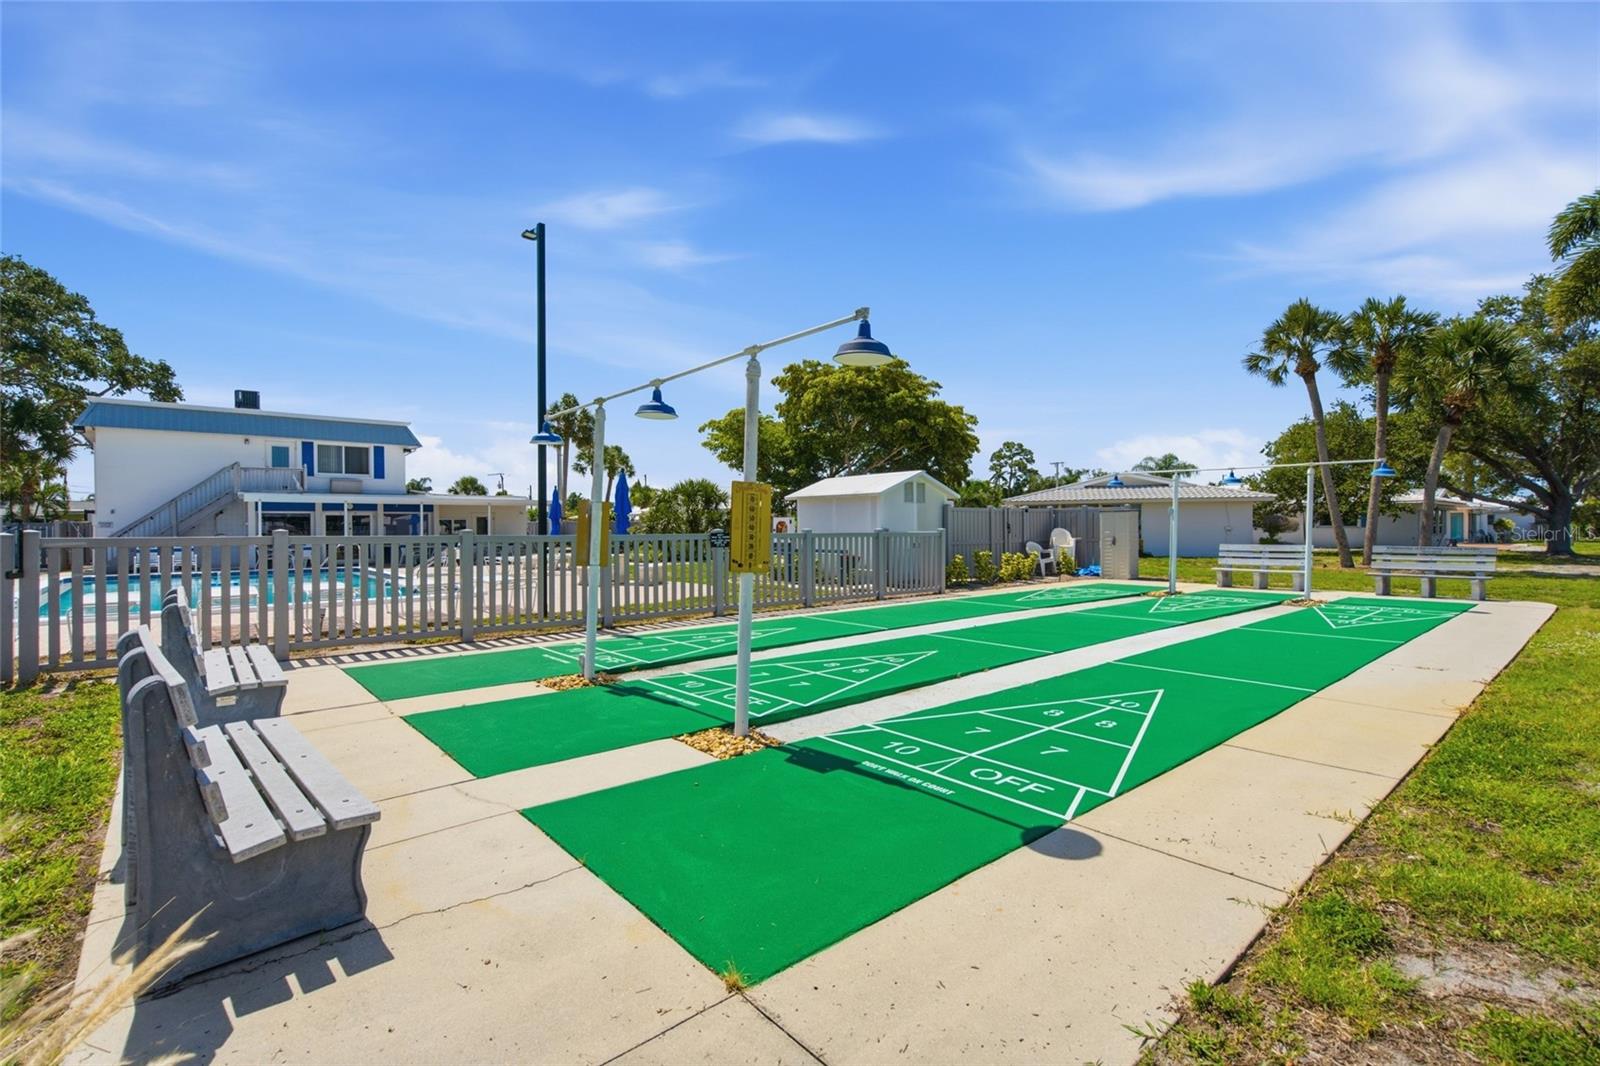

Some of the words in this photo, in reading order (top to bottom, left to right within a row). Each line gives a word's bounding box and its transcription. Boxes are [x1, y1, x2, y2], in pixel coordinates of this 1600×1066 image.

[1108, 698, 1140, 708] 10
[1043, 709, 1065, 717] 8
[1094, 720, 1117, 729] 8
[965, 726, 991, 734] 7
[883, 741, 920, 755] 10
[1040, 745, 1069, 755] 7
[970, 768, 1055, 793] OFF
